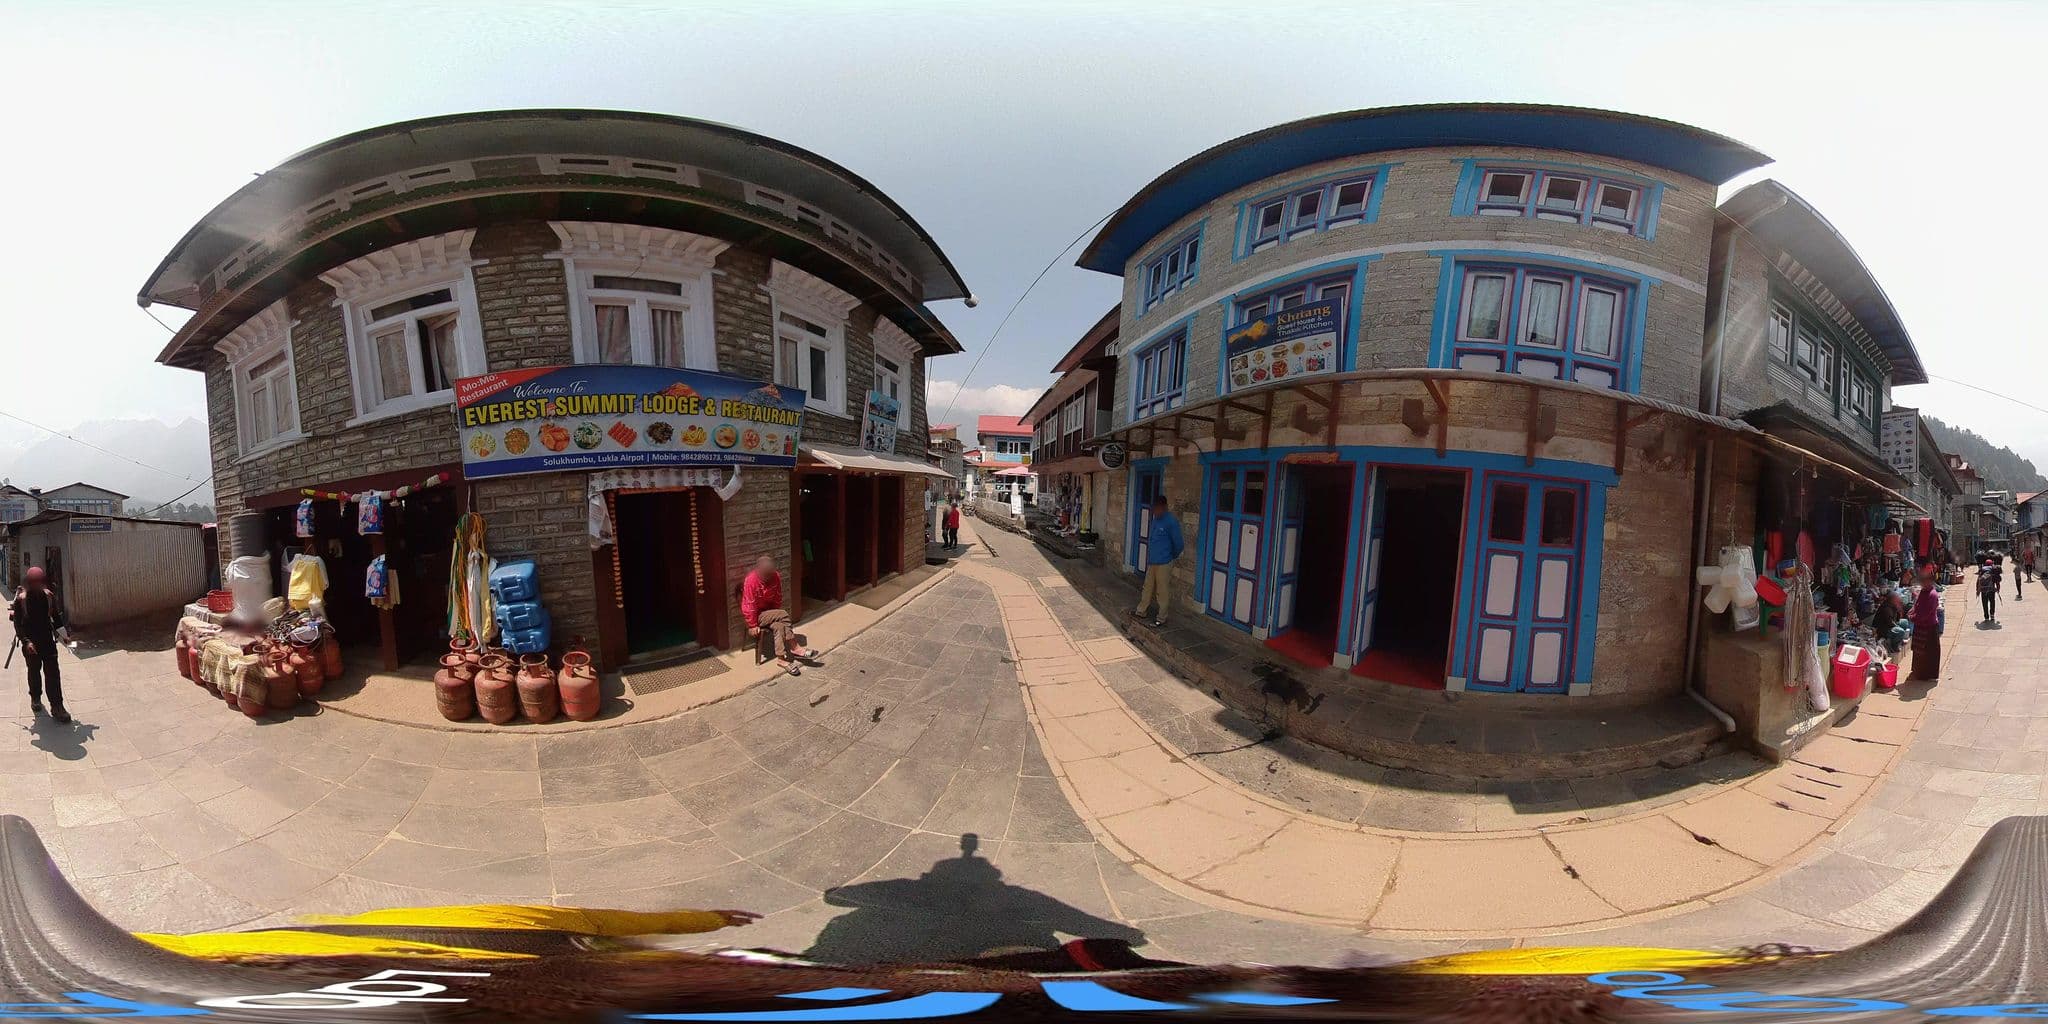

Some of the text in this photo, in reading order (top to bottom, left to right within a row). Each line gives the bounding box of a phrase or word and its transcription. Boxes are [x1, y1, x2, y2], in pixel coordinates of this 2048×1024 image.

[460, 379, 509, 404] Restaurant
[513, 380, 588, 399] Welcome To
[464, 394, 801, 427] EVEREST SUMMIT LODGE & RESTAURANT
[543, 455, 596, 467] Solukhumbu,
[598, 454, 619, 463] Lukla
[620, 453, 644, 464] Airpot
[652, 453, 680, 462] Mobile:
